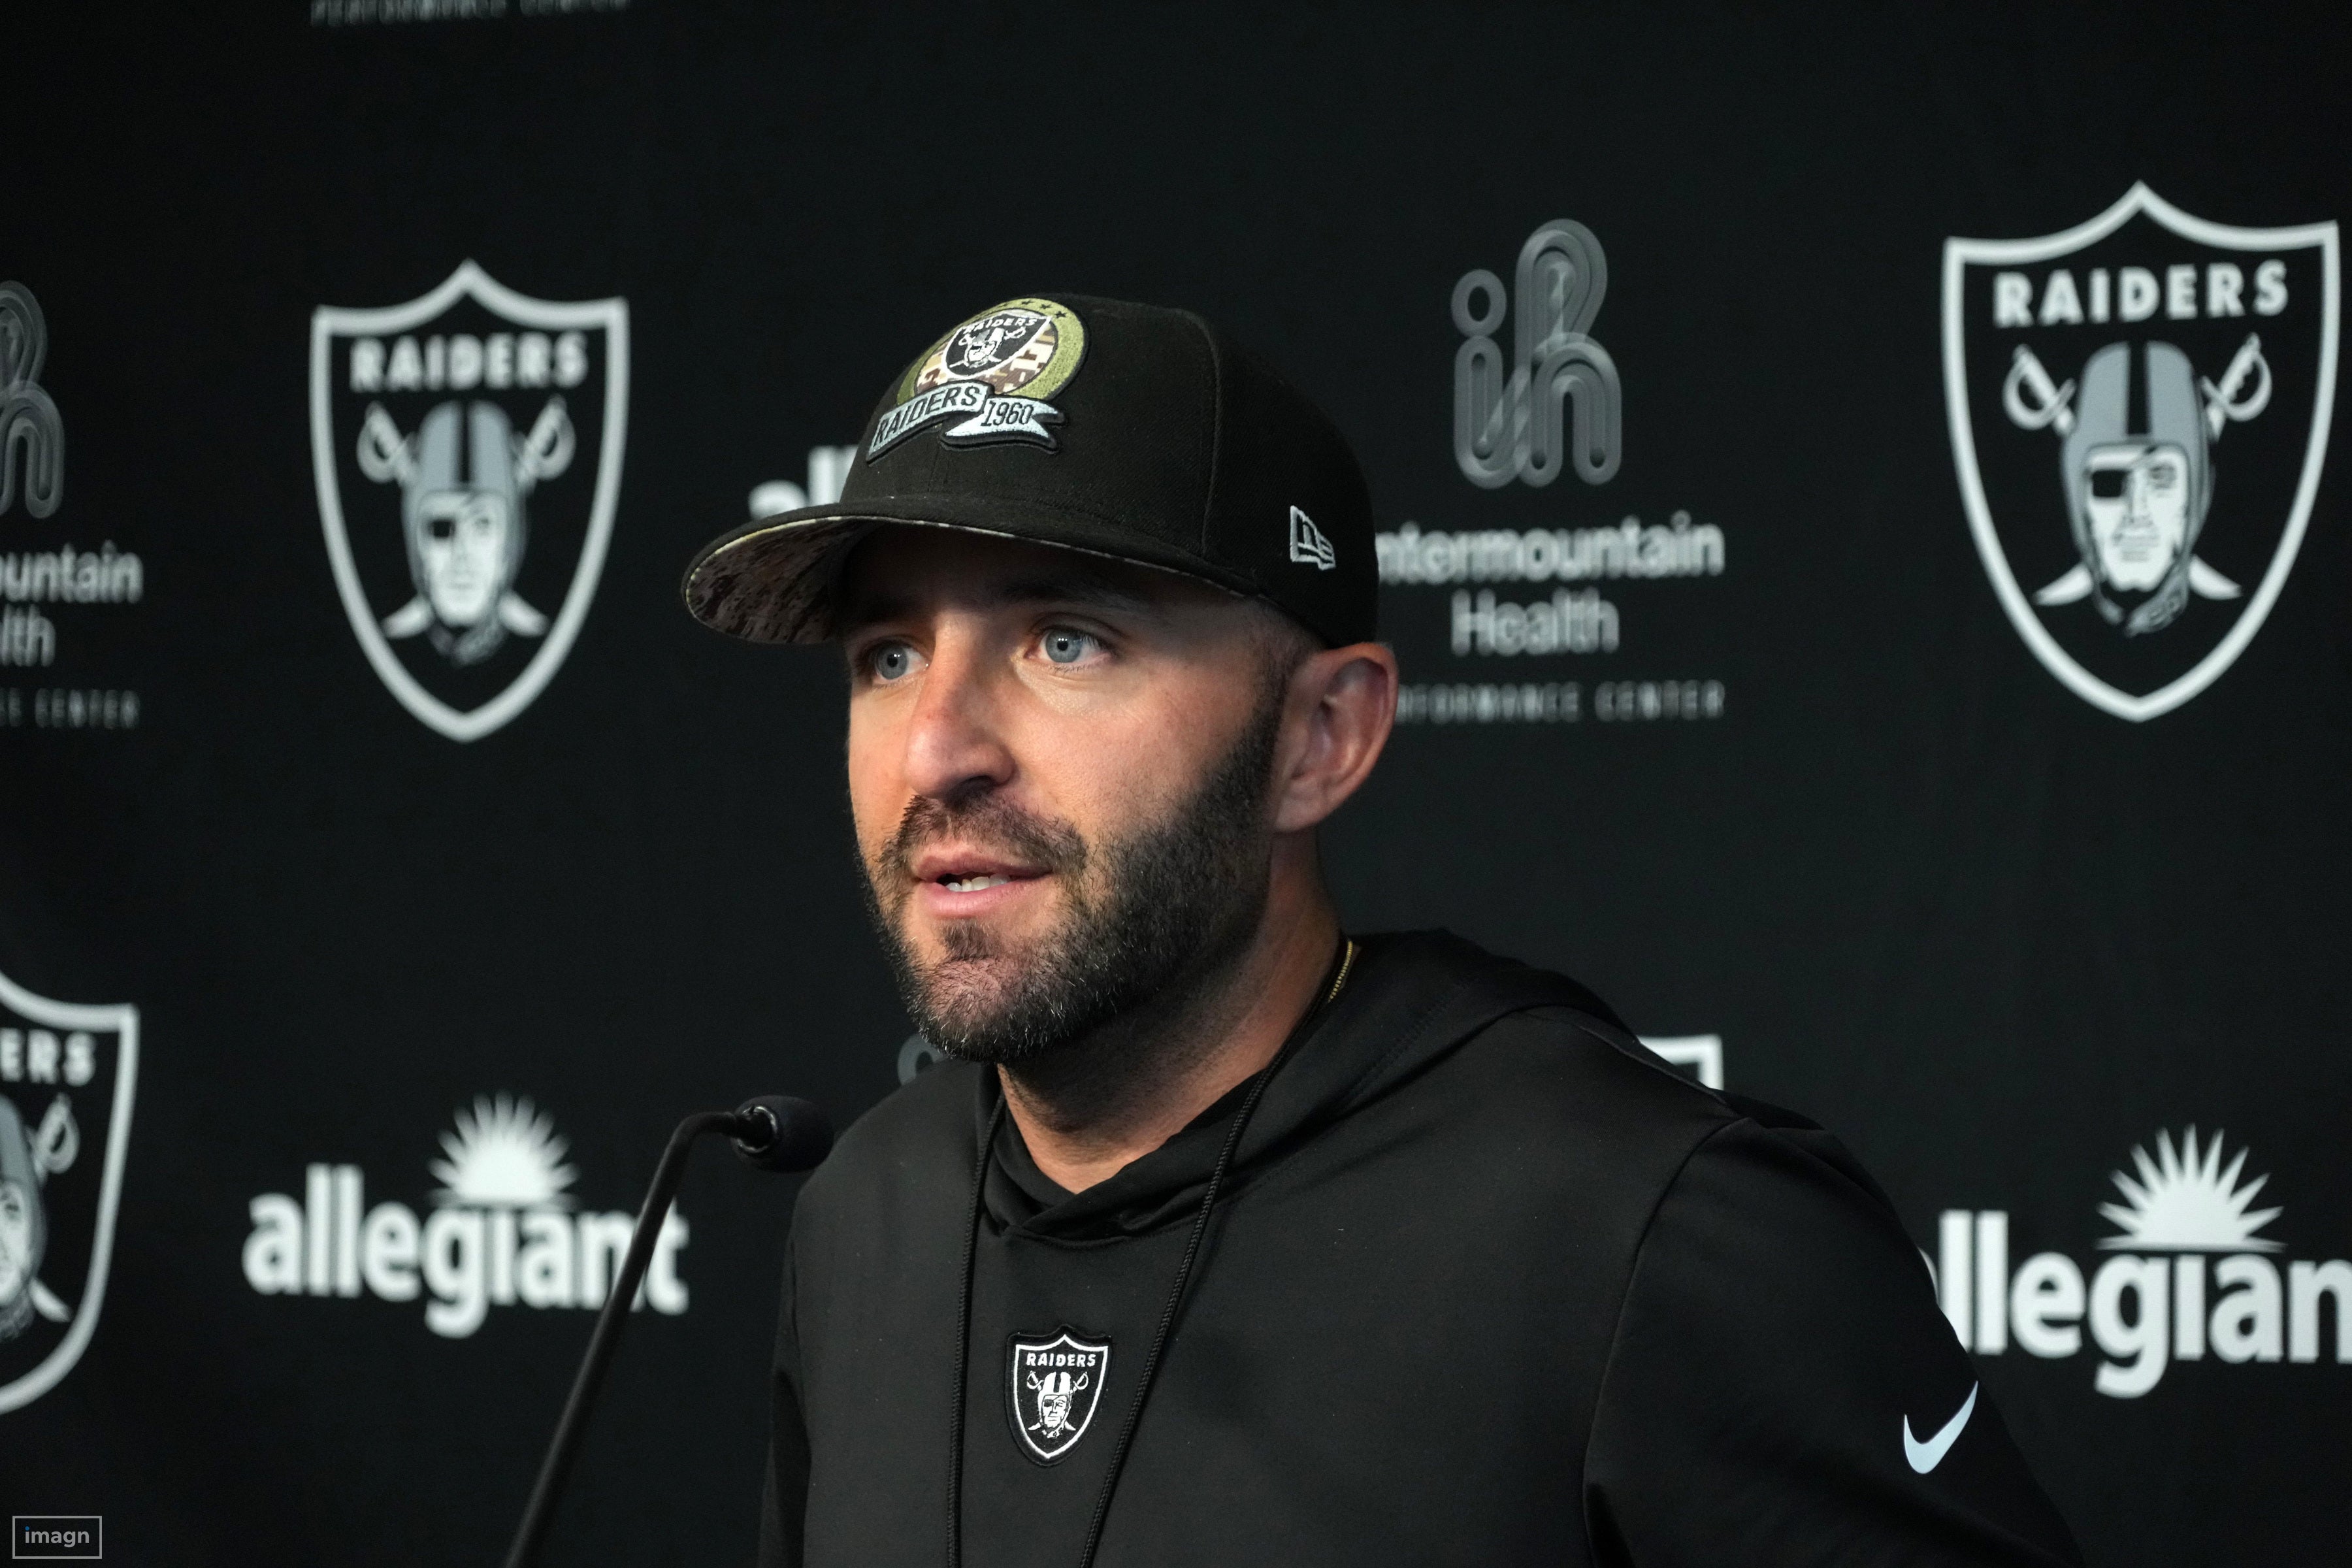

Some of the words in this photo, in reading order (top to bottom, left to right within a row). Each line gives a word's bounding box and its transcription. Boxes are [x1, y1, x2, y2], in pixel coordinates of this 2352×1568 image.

[1993, 259, 2289, 327] RAIDERS
[962, 318, 1037, 335] RAIDERS
[350, 331, 588, 392] RAIDERS
[873, 386, 980, 448] RAIDERS
[980, 400, 1034, 427] 1960
[0, 540, 144, 603] untain
[1375, 510, 1725, 584] ntermountain
[0, 604, 56, 667] lth
[1451, 587, 1619, 656] Health
[1595, 679, 1725, 721] CENTER
[242, 1162, 690, 1339] allegiant
[1918, 1209, 2352, 1398] llegian
[1026, 1352, 1096, 1367] RAIDERS
